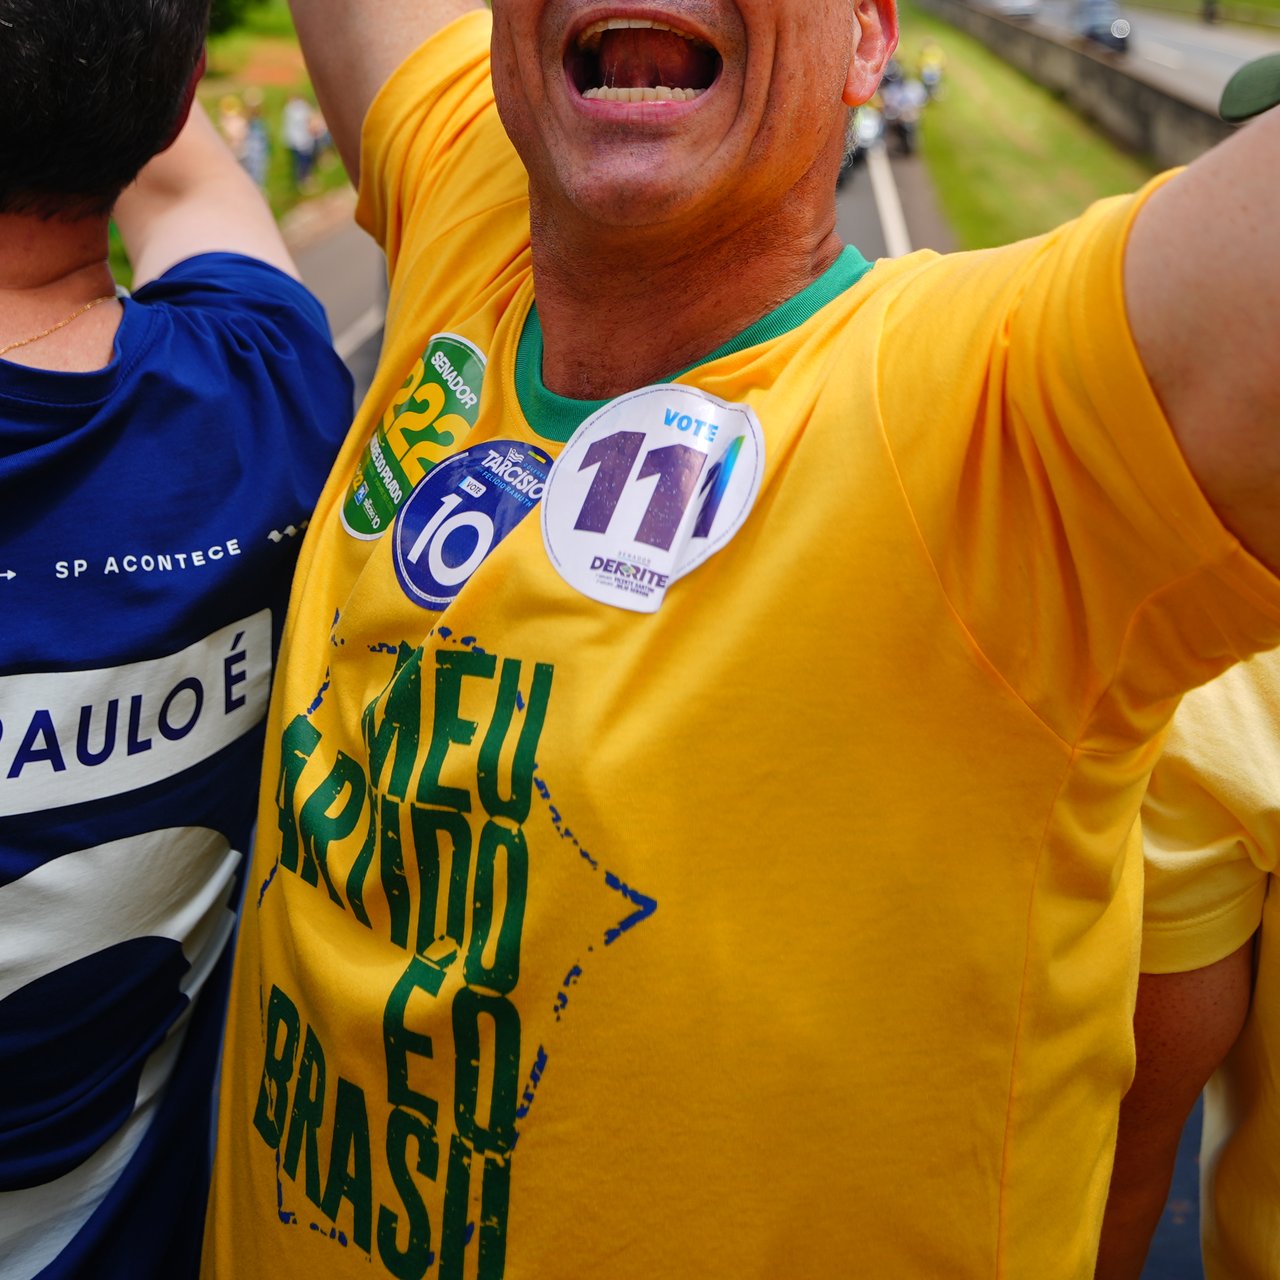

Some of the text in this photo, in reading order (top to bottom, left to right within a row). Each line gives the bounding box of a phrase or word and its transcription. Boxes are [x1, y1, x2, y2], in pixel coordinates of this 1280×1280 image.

[430, 351, 478, 409] SENADOR
[663, 408, 718, 443] VOTE
[465, 480, 482, 495] VOTE
[481, 450, 546, 499] TARCÍSIO
[55, 558, 88, 581] SP
[104, 538, 242, 575] ACONTECE
[407, 493, 494, 586] 10
[223, 631, 250, 716] É
[451, 985, 521, 1156] O
